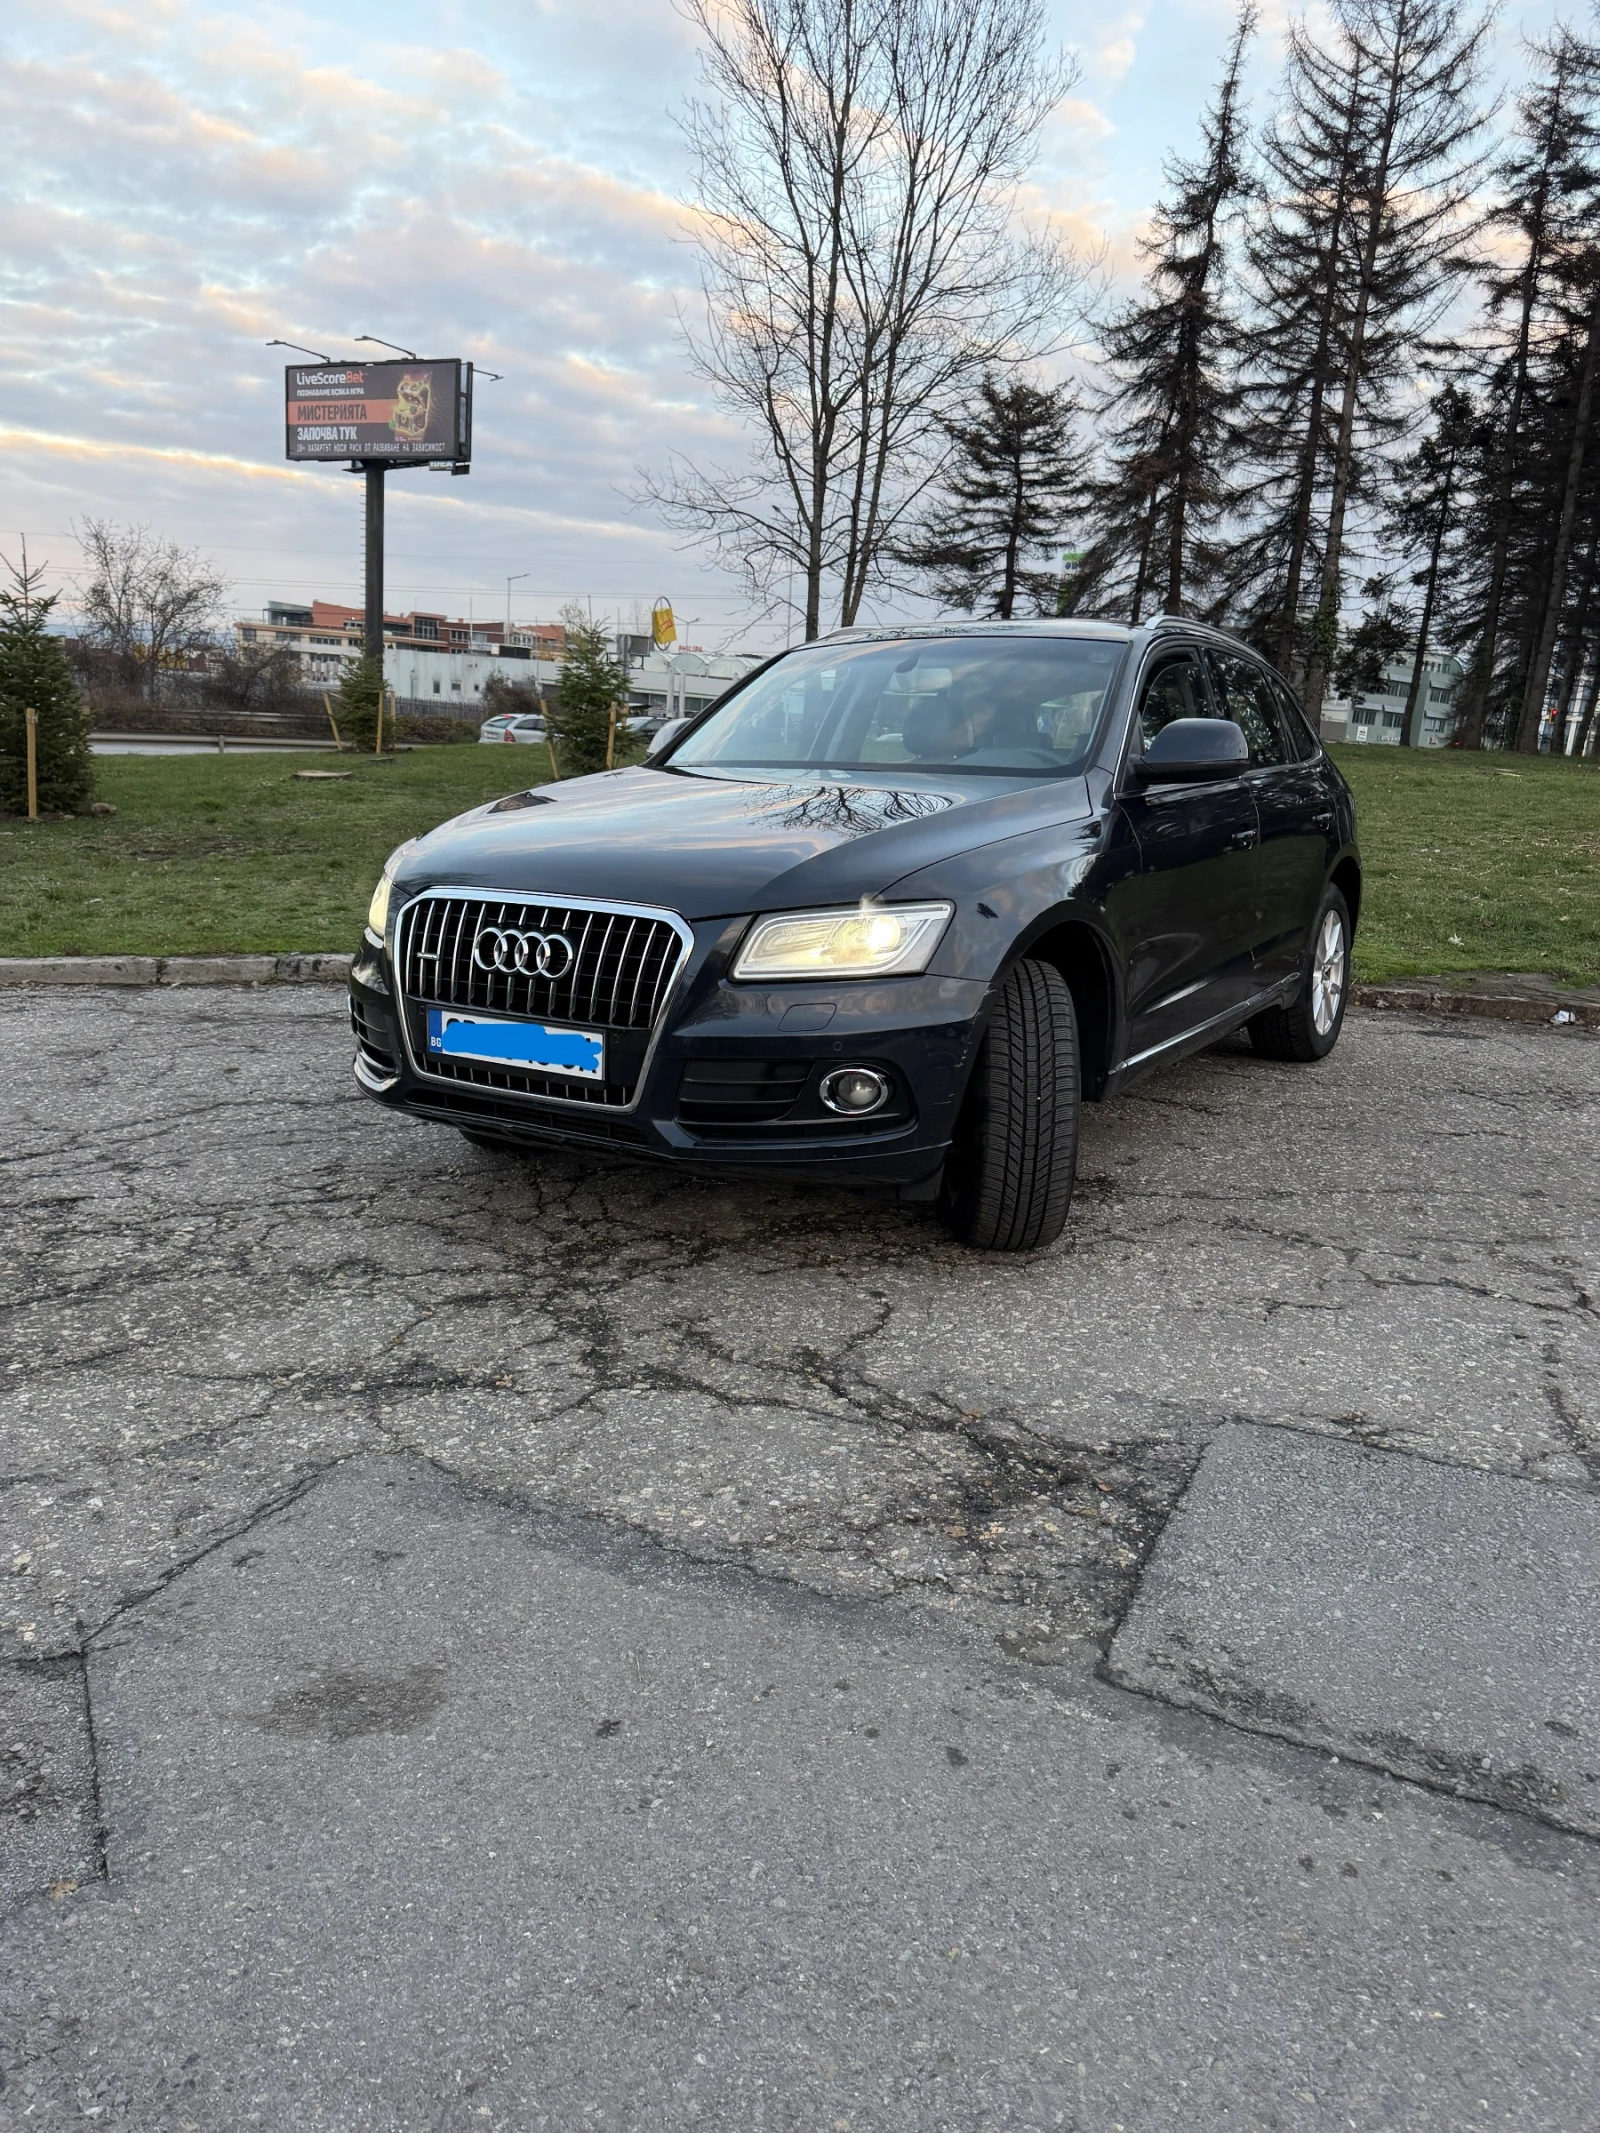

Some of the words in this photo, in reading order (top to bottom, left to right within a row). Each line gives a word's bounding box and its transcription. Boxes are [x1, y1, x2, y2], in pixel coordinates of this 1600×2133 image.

[296, 370, 364, 385] LiveScoreBet
[350, 387, 364, 395] ИГРА
[297, 403, 368, 421] МИСТЕРИЯТА
[297, 426, 338, 440] ЗАПОЧВА
[339, 426, 358, 440] ТУК
[334, 443, 347, 452] НОСИ
[349, 443, 362, 452] РИСК
[364, 443, 371, 452] ОТ
[402, 442, 410, 452] НА
[412, 442, 446, 452] ЗАВИСИМОСТ
[430, 1036, 442, 1048] BG
